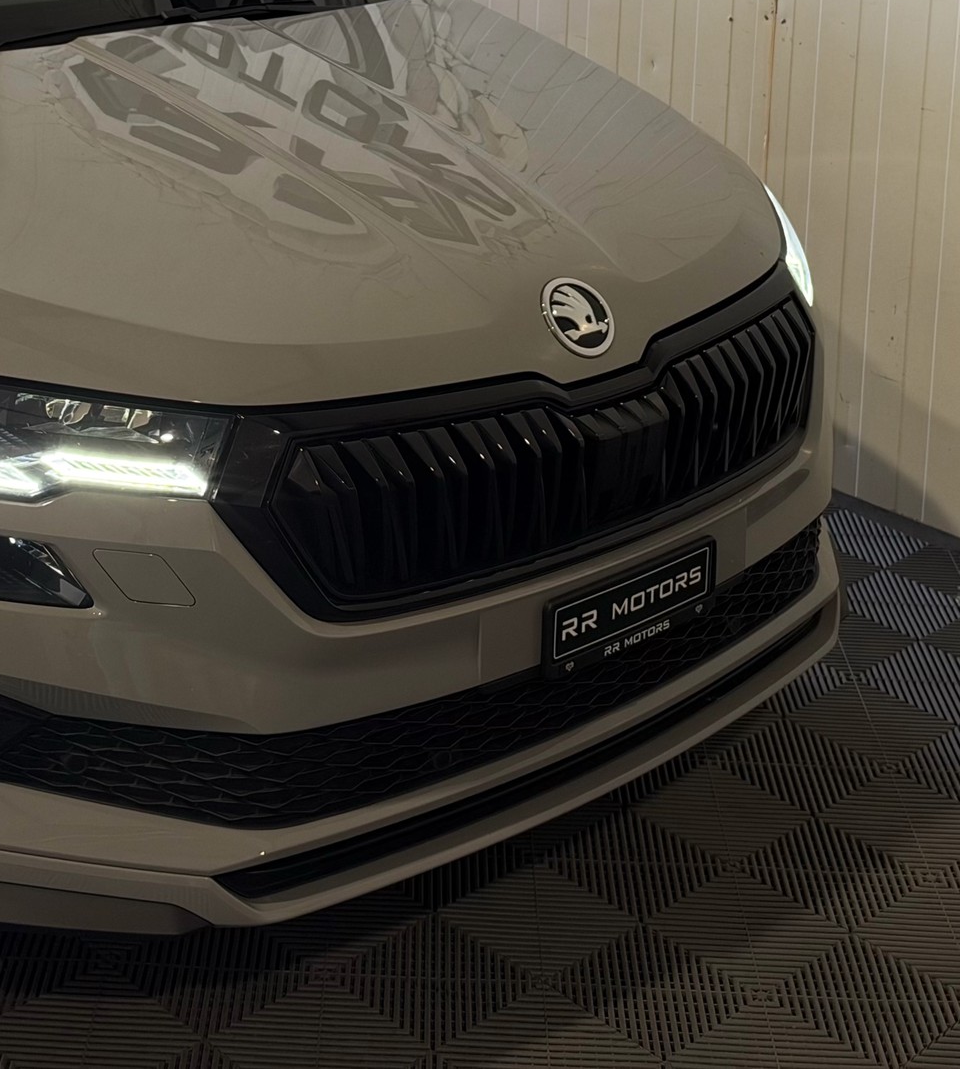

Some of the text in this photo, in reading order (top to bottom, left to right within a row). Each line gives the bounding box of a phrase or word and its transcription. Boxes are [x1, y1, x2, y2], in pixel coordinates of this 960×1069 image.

[561, 565, 702, 641] RR MOTORS
[604, 619, 670, 656] RR MOTORS
